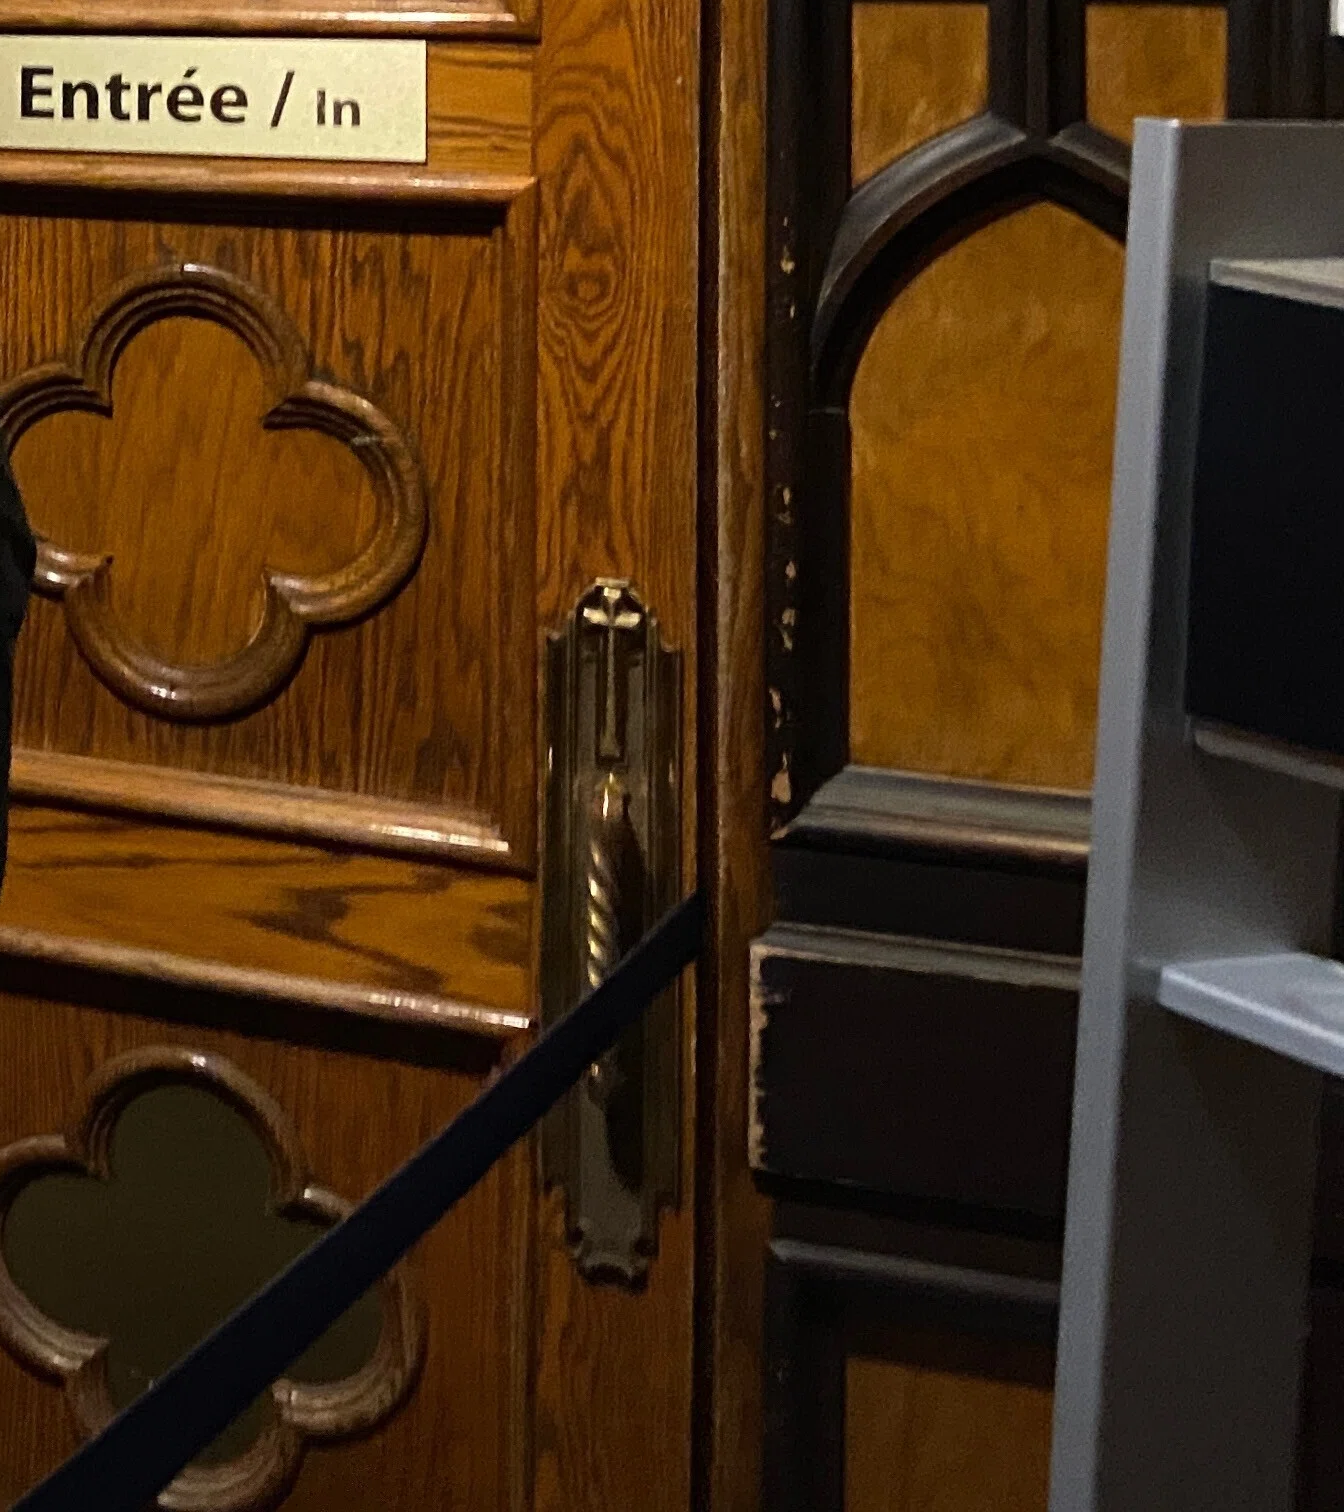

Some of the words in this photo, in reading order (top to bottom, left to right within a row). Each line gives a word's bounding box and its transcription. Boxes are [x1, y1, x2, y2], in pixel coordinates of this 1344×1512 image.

[19, 65, 249, 124] Entrée
[269, 70, 296, 129] /
[315, 89, 362, 127] In
